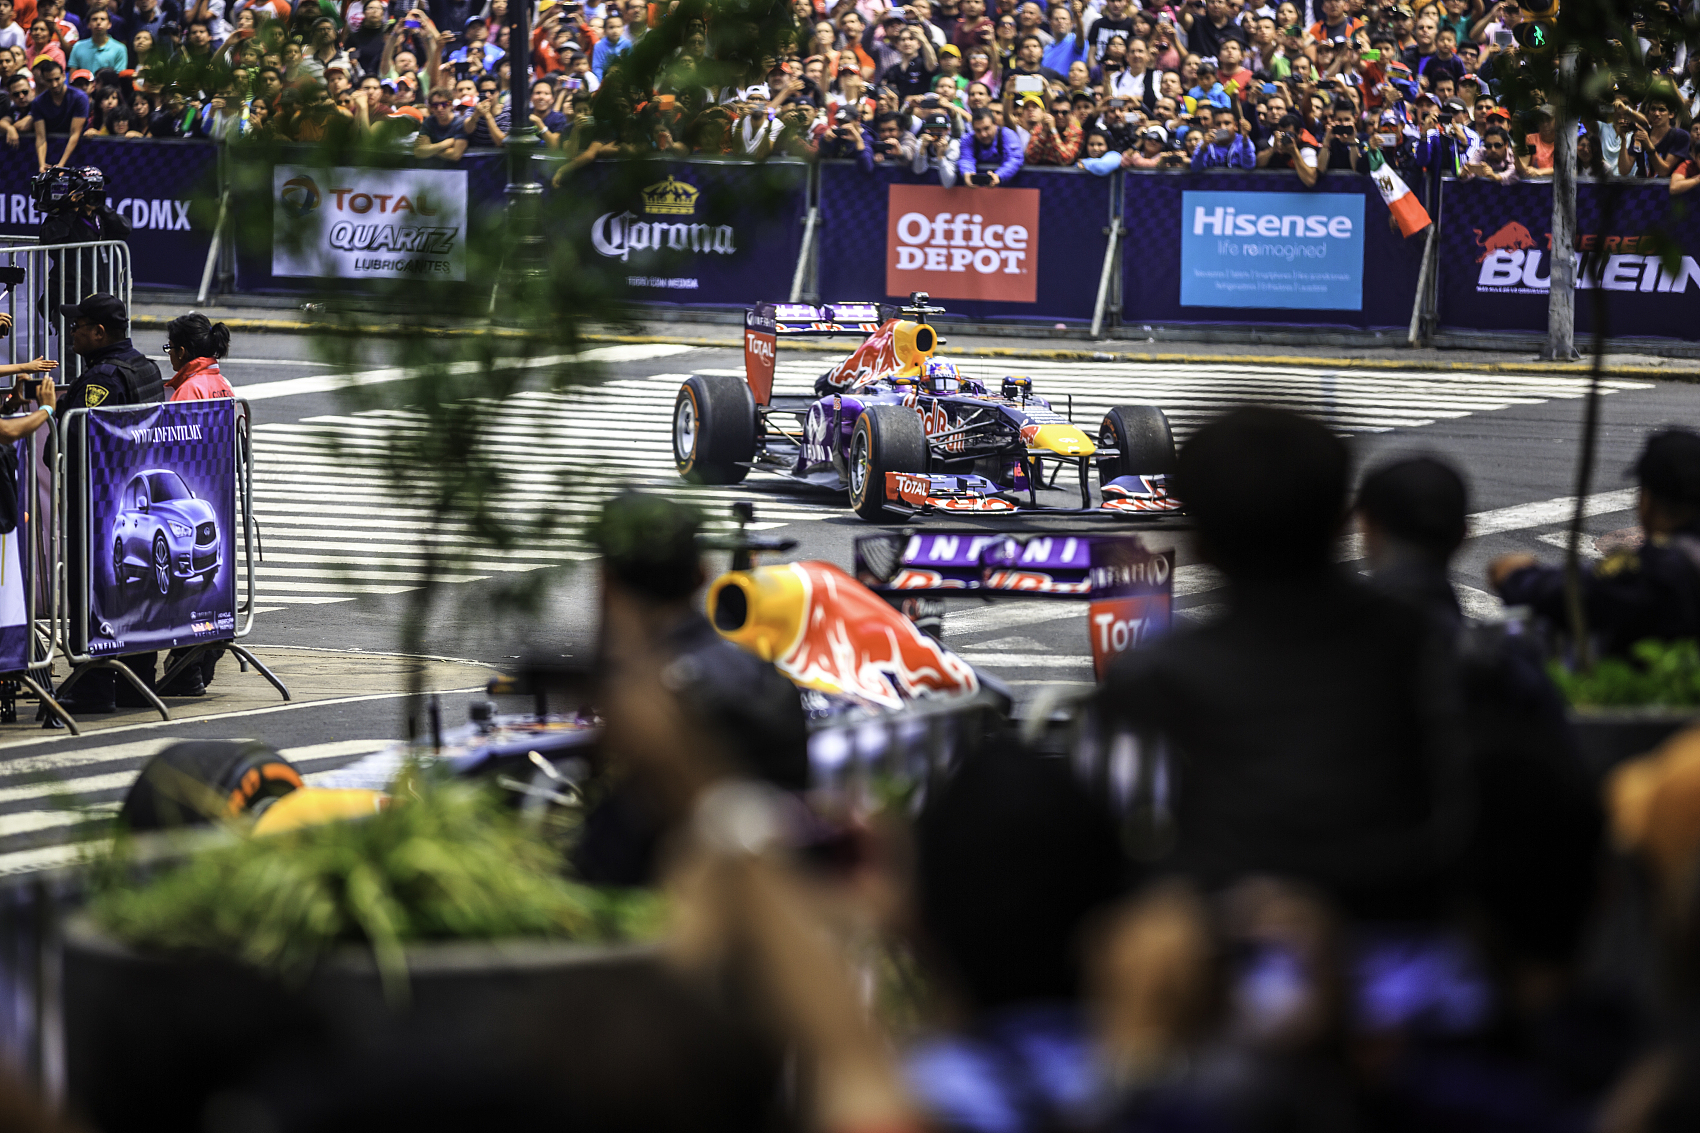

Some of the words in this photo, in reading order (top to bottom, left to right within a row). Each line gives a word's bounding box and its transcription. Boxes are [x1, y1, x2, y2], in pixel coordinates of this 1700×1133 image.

[329, 188, 437, 217] TOTAL
[591, 210, 738, 262] Corona
[896, 212, 1029, 249] Office
[1193, 206, 1353, 239] Hisense
[329, 220, 459, 254] QUARTZ
[1217, 239, 1240, 256] life
[1242, 242, 1328, 262] reimagined
[354, 258, 451, 274] LUBRICANTES
[895, 246, 1026, 274] DEPOT
[747, 333, 775, 358] TOTAL
[895, 475, 928, 497] TOTAL
